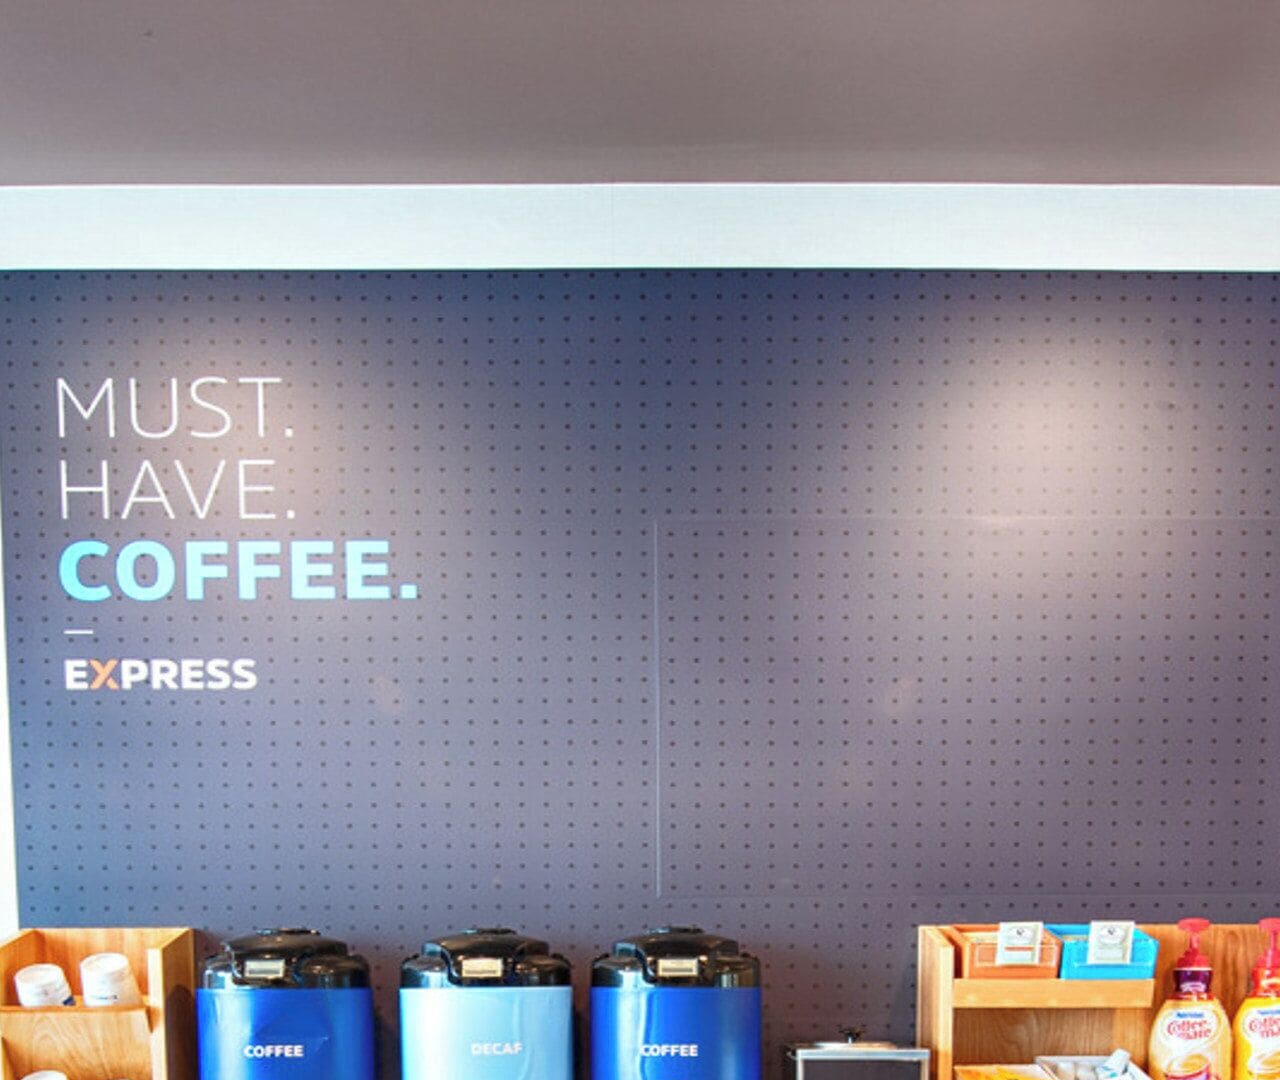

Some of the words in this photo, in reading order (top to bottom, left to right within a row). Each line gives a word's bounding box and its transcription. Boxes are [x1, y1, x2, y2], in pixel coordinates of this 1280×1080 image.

[57, 376, 293, 438] MUST.
[60, 459, 295, 519] HAVE.
[58, 540, 418, 601] COFFEE.
[64, 659, 258, 690] EXPRESS
[243, 1045, 305, 1058] COFFEE
[471, 1042, 523, 1056] DECAF
[640, 1044, 699, 1058] COFFEE
